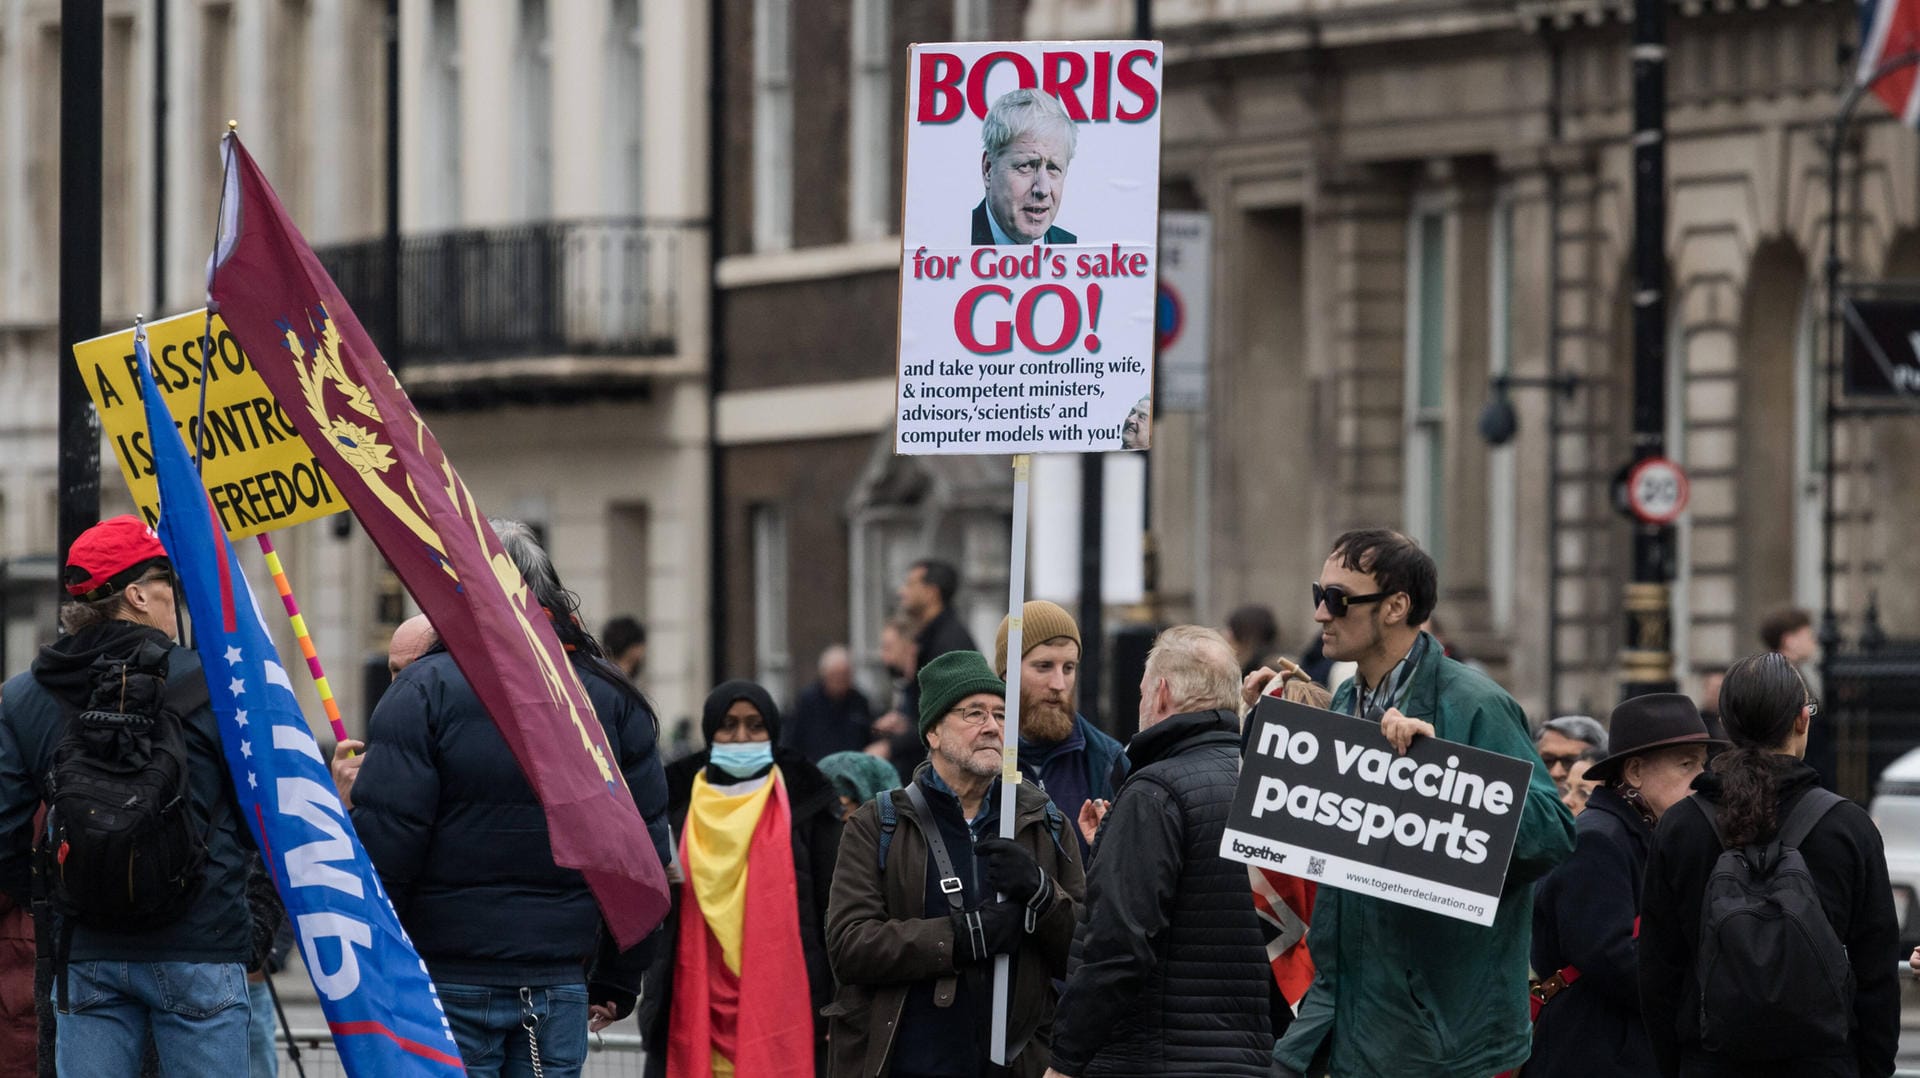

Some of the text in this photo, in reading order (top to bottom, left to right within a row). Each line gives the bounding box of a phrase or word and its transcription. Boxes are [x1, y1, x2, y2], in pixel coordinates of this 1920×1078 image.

[917, 49, 1158, 123] BORIS
[912, 246, 960, 279] for
[970, 245, 1066, 279] God's
[1076, 243, 1148, 278] sake
[953, 282, 1102, 355] GO!
[94, 362, 124, 409] A
[903, 355, 1146, 381] and take your controlling wife,
[903, 380, 1105, 404] & incompetent ministers,
[1058, 401, 1088, 419] and
[116, 431, 157, 480] IS
[901, 424, 1122, 449] computer models with you!
[1256, 720, 1514, 816] no vaccine
[1250, 775, 1491, 865] passports
[1232, 838, 1287, 864] together
[1346, 871, 1485, 917] www.togetherdeclaration.org
